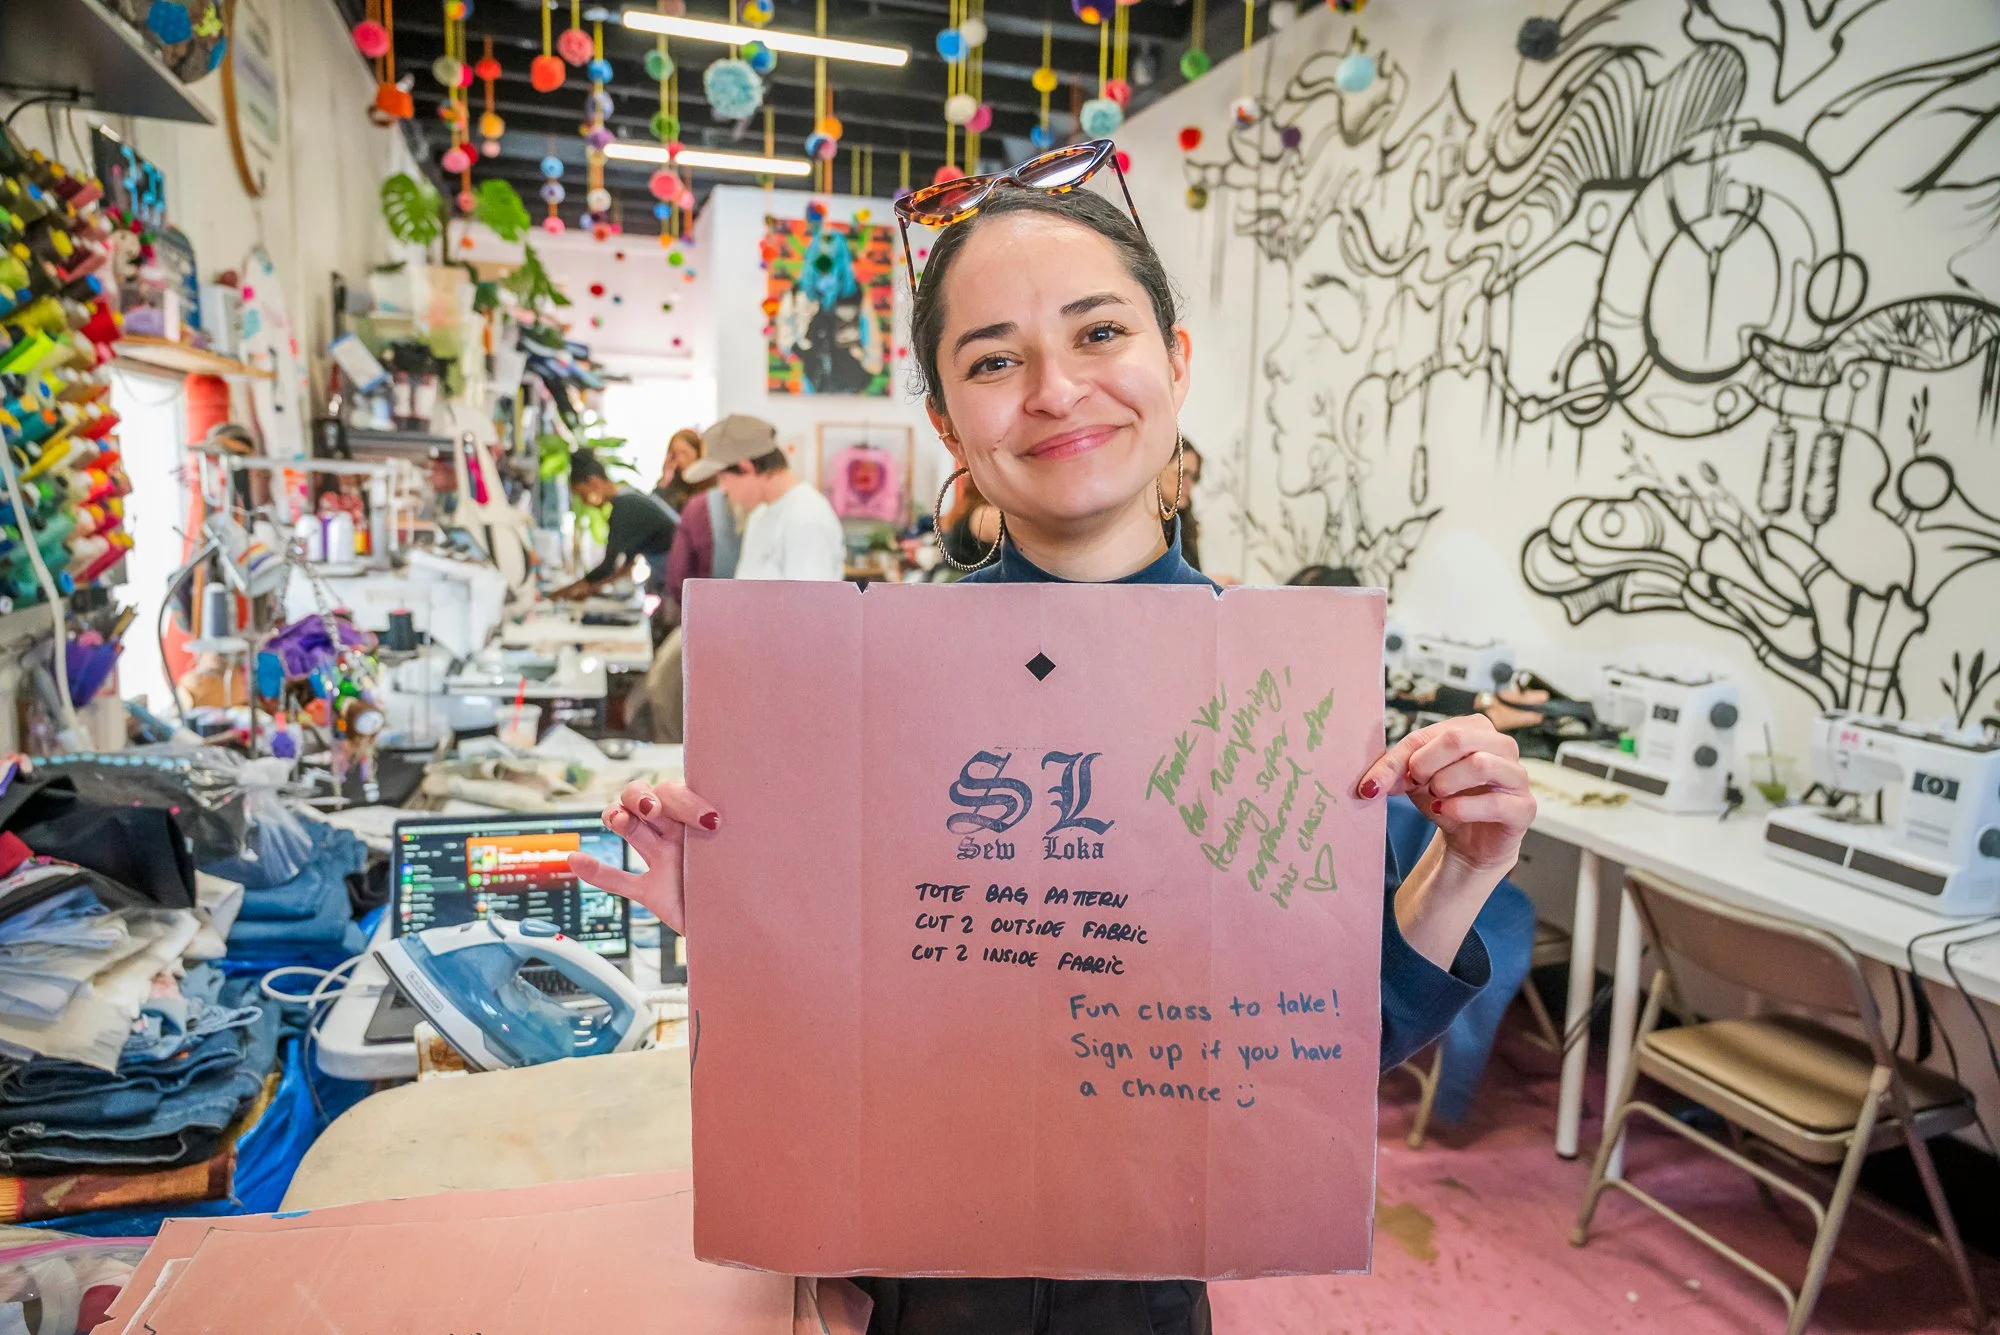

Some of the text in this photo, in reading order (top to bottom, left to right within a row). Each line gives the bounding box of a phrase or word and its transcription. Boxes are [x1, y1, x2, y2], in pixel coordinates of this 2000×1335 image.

[1303, 687, 1335, 752] after
[1145, 728, 1199, 806] Thank
[1256, 720, 1289, 794] super
[956, 836, 1105, 860] Sew Loka
[1269, 780, 1338, 910] this class!
[915, 882, 1129, 909] TOTE BAG PATTERN
[915, 913, 954, 933] CUT
[960, 915, 974, 934] 2
[990, 917, 1066, 938] OUTSIDE
[911, 944, 948, 962] CUT
[955, 944, 968, 961] 2
[982, 947, 1039, 968] INSIDE
[1070, 988, 1340, 1021] Fun class to take!
[1070, 1032, 1343, 1070] Sign up if you have
[1079, 1077, 1222, 1102] a chance
